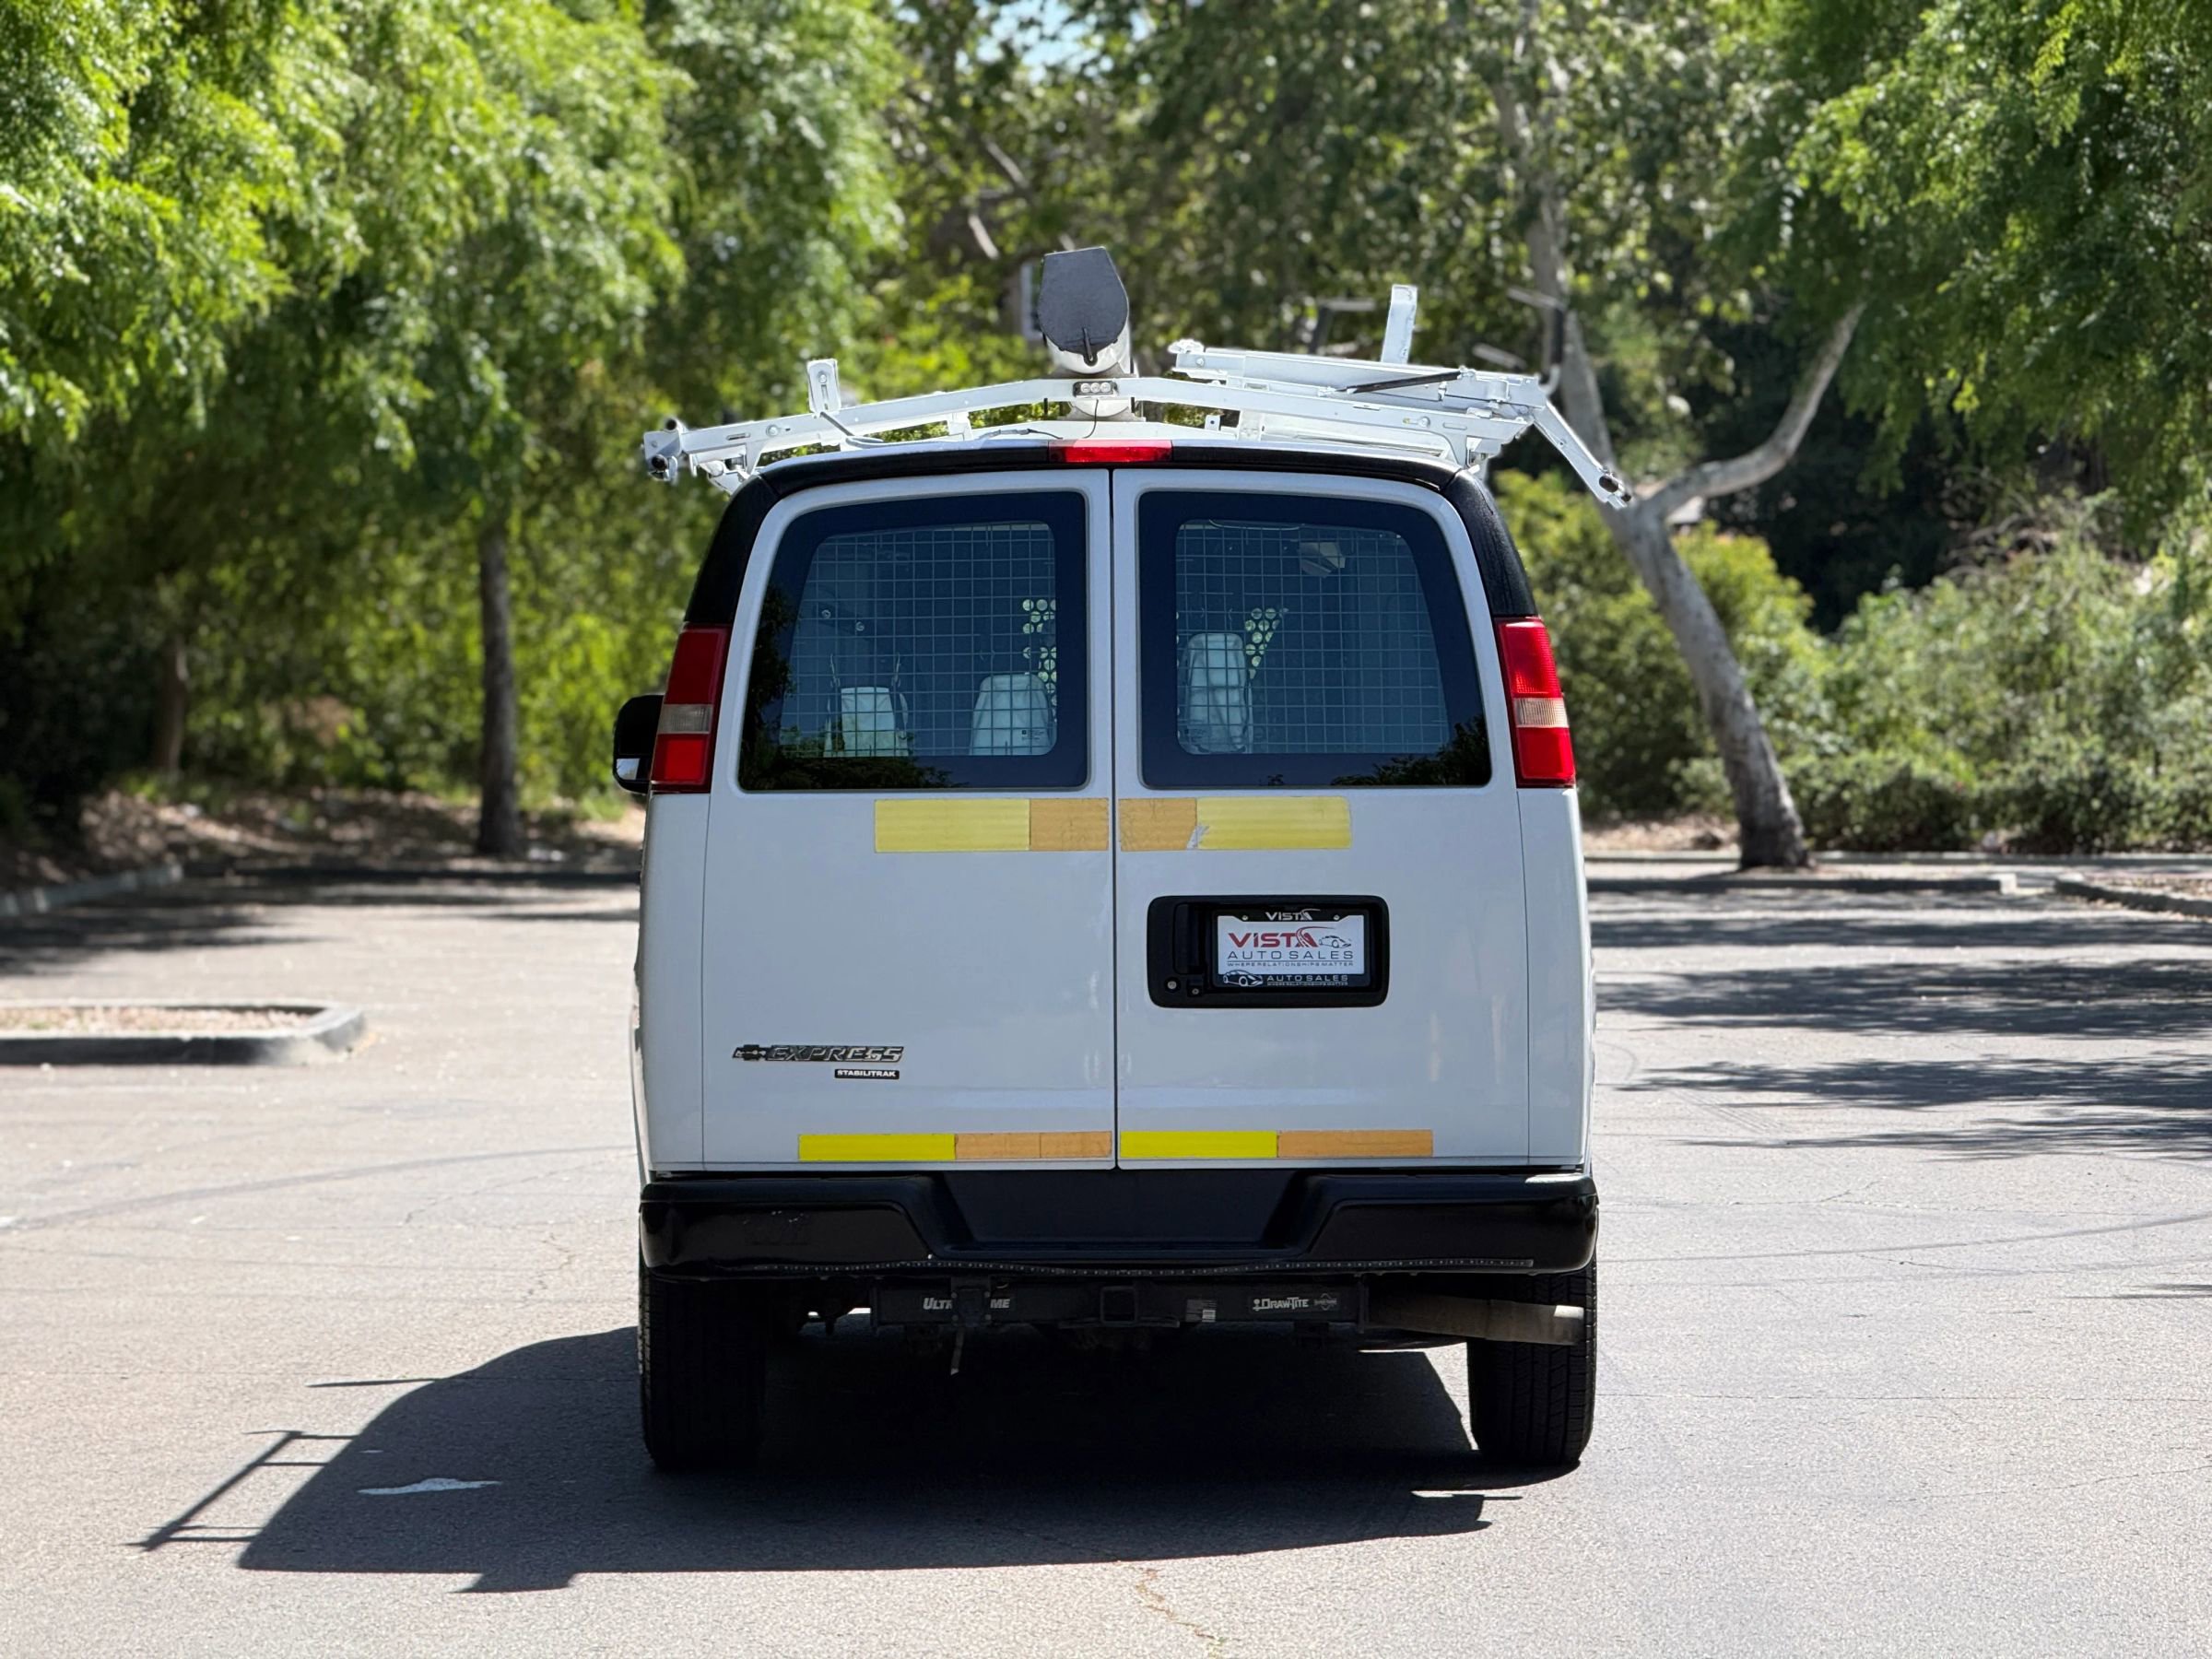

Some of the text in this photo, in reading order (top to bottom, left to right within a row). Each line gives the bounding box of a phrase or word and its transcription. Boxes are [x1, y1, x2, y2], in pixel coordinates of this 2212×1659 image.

[1265, 910, 1314, 921] VISTA
[1228, 929, 1318, 948] VISTA
[1227, 950, 1354, 959] AUTO SALES
[771, 1045, 904, 1062] EXPRESS
[837, 1069, 897, 1077] STABILITRAK
[923, 1297, 953, 1310] ULTR
